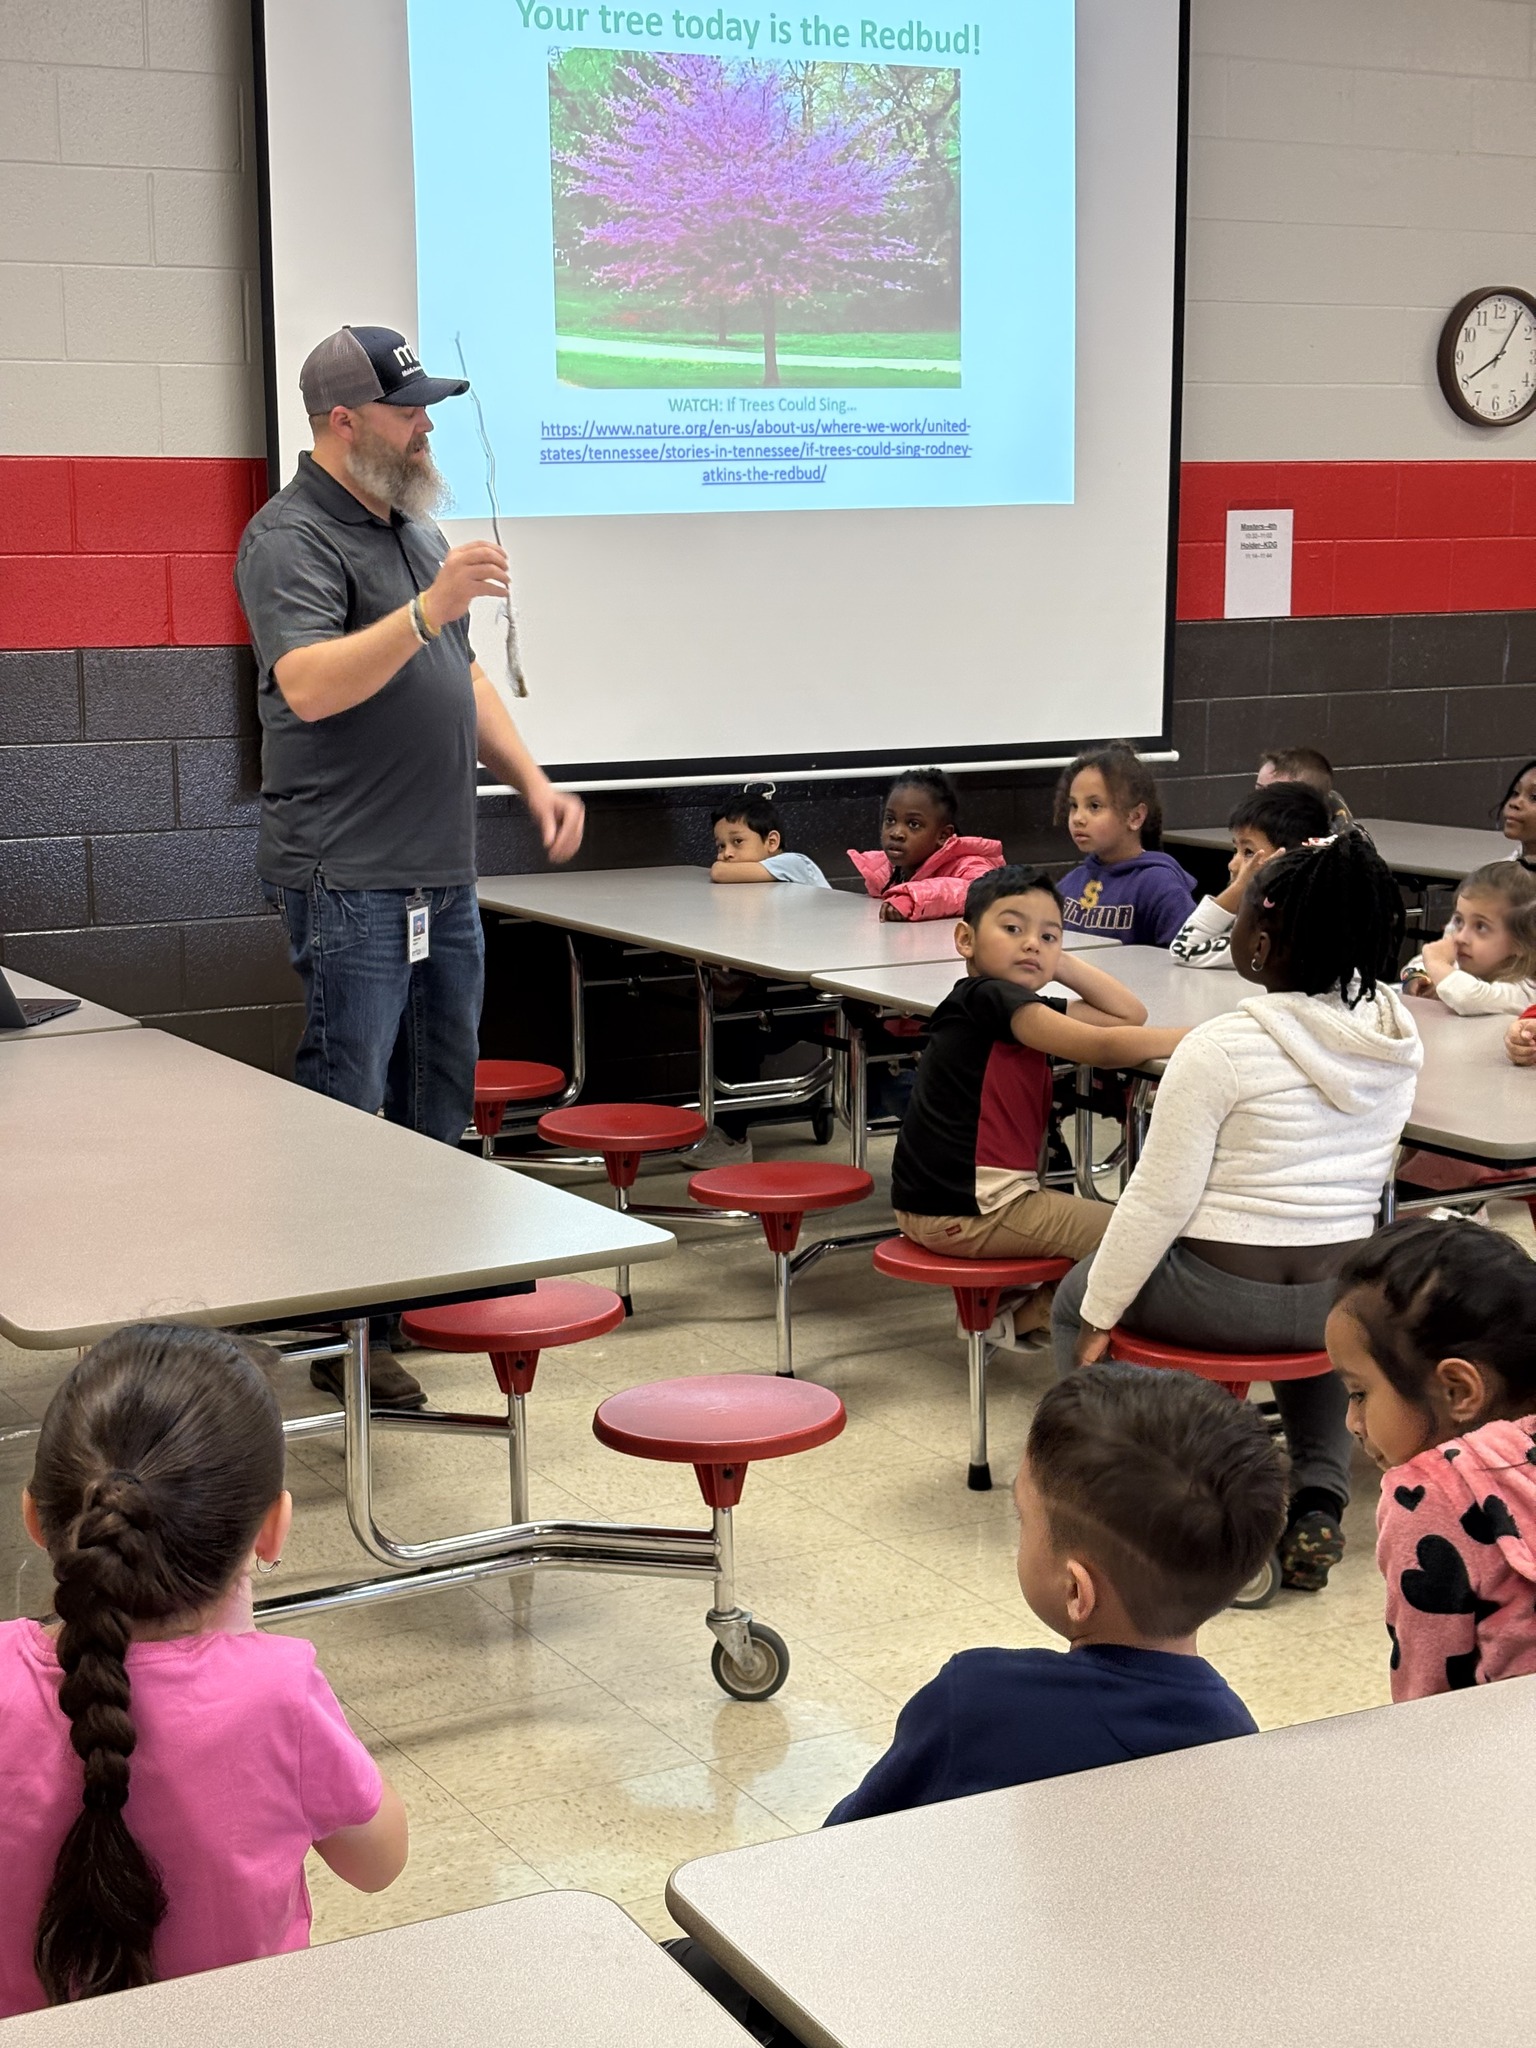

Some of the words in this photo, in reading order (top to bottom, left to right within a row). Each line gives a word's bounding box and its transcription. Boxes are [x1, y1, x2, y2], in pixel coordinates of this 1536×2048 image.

[516, 0, 589, 31] Your
[598, 4, 663, 36] tree
[672, 8, 760, 49] today
[770, 12, 792, 44] is
[800, 14, 850, 47] the
[860, 19, 980, 55] Redbud!
[1477, 311, 1488, 326] 11
[1494, 304, 1507, 319] 12
[1464, 328, 1476, 343] 10
[1524, 326, 1532, 340] 2
[1456, 351, 1464, 365] 9
[1461, 374, 1470, 390] 8
[1522, 372, 1530, 387] 4
[668, 398, 723, 412] WATCH:
[727, 397, 736, 411] If
[740, 398, 775, 412] Trees
[778, 396, 816, 411] Could
[819, 397, 858, 414] Sing...
[1475, 391, 1482, 406] 7
[1491, 396, 1500, 411] 6
[1508, 390, 1517, 405] 5
[541, 418, 971, 439] https://www.nature.org/en-us/about-us/where-we-work/united-
[540, 440, 973, 464] states/tennessee/stories-in-tennessee/if-trees-could-sing-rodney-
[702, 464, 827, 484] atkins-the-redbud/
[1080, 880, 1103, 909] S
